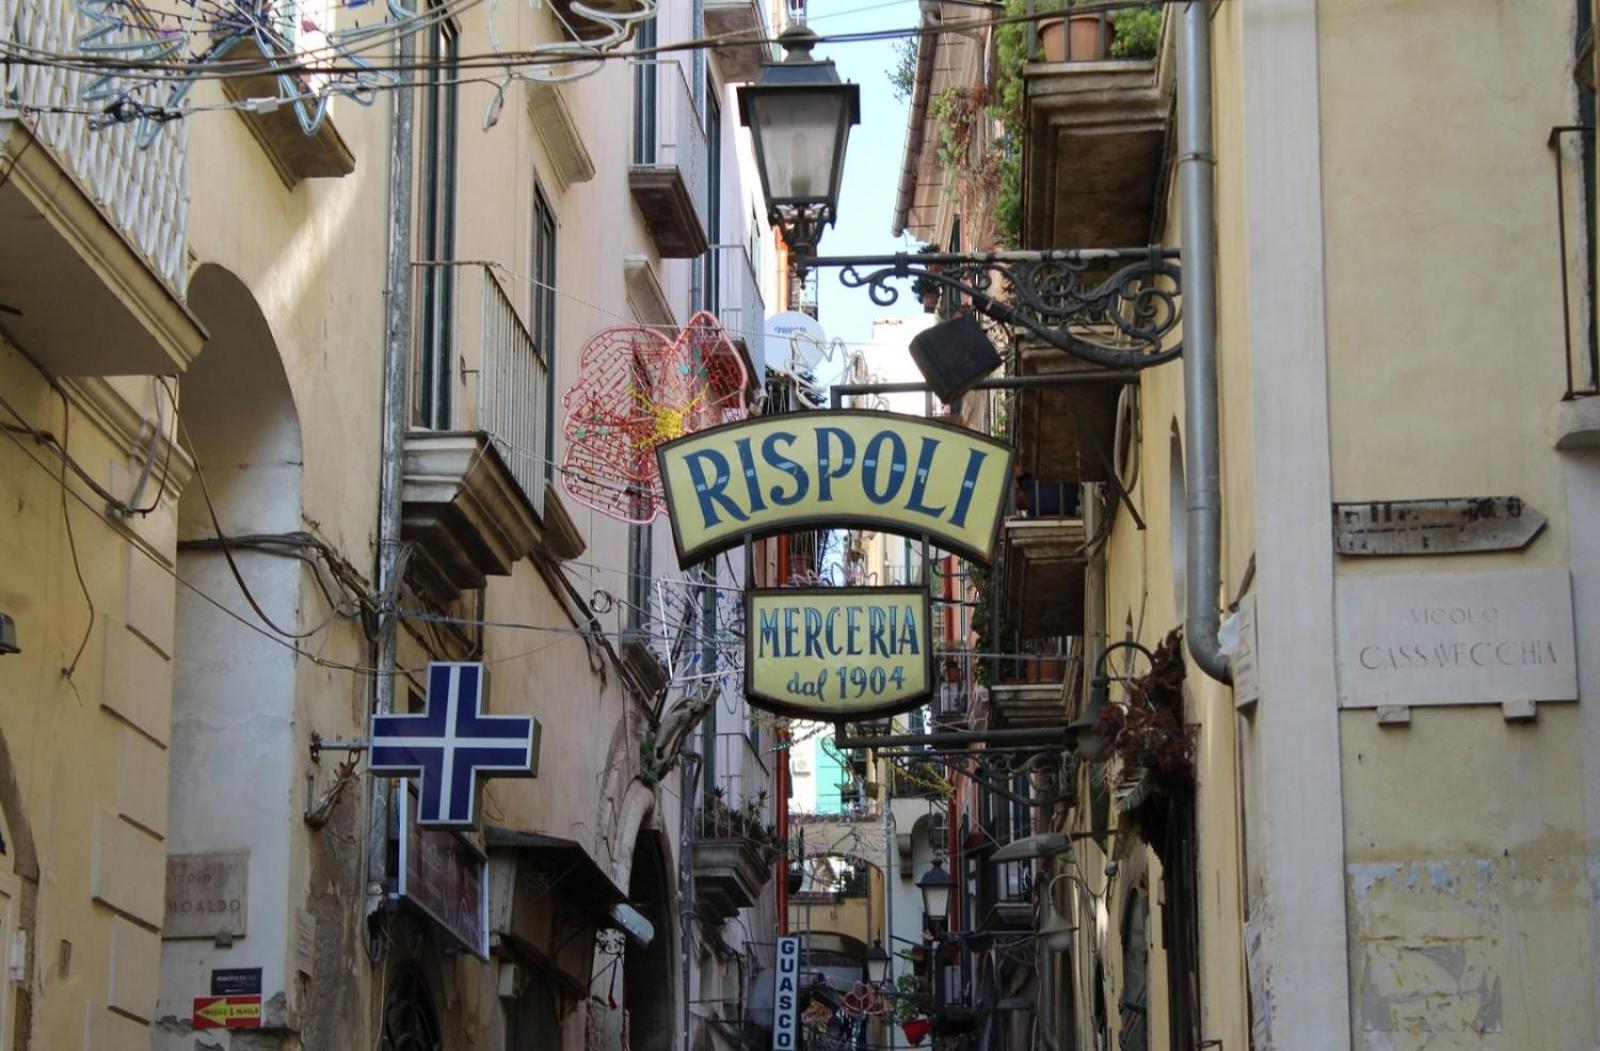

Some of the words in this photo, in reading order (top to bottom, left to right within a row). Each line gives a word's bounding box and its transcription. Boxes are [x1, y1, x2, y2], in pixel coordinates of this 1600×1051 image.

[682, 427, 988, 529] RISPOLI
[758, 605, 919, 660] MERCERIA
[1410, 607, 1501, 625] VICOLO
[1359, 640, 1557, 670] CASSAVECCHIA
[786, 672, 826, 701] dal
[836, 666, 906, 699] 1904
[778, 940, 795, 1047] GUASCO
